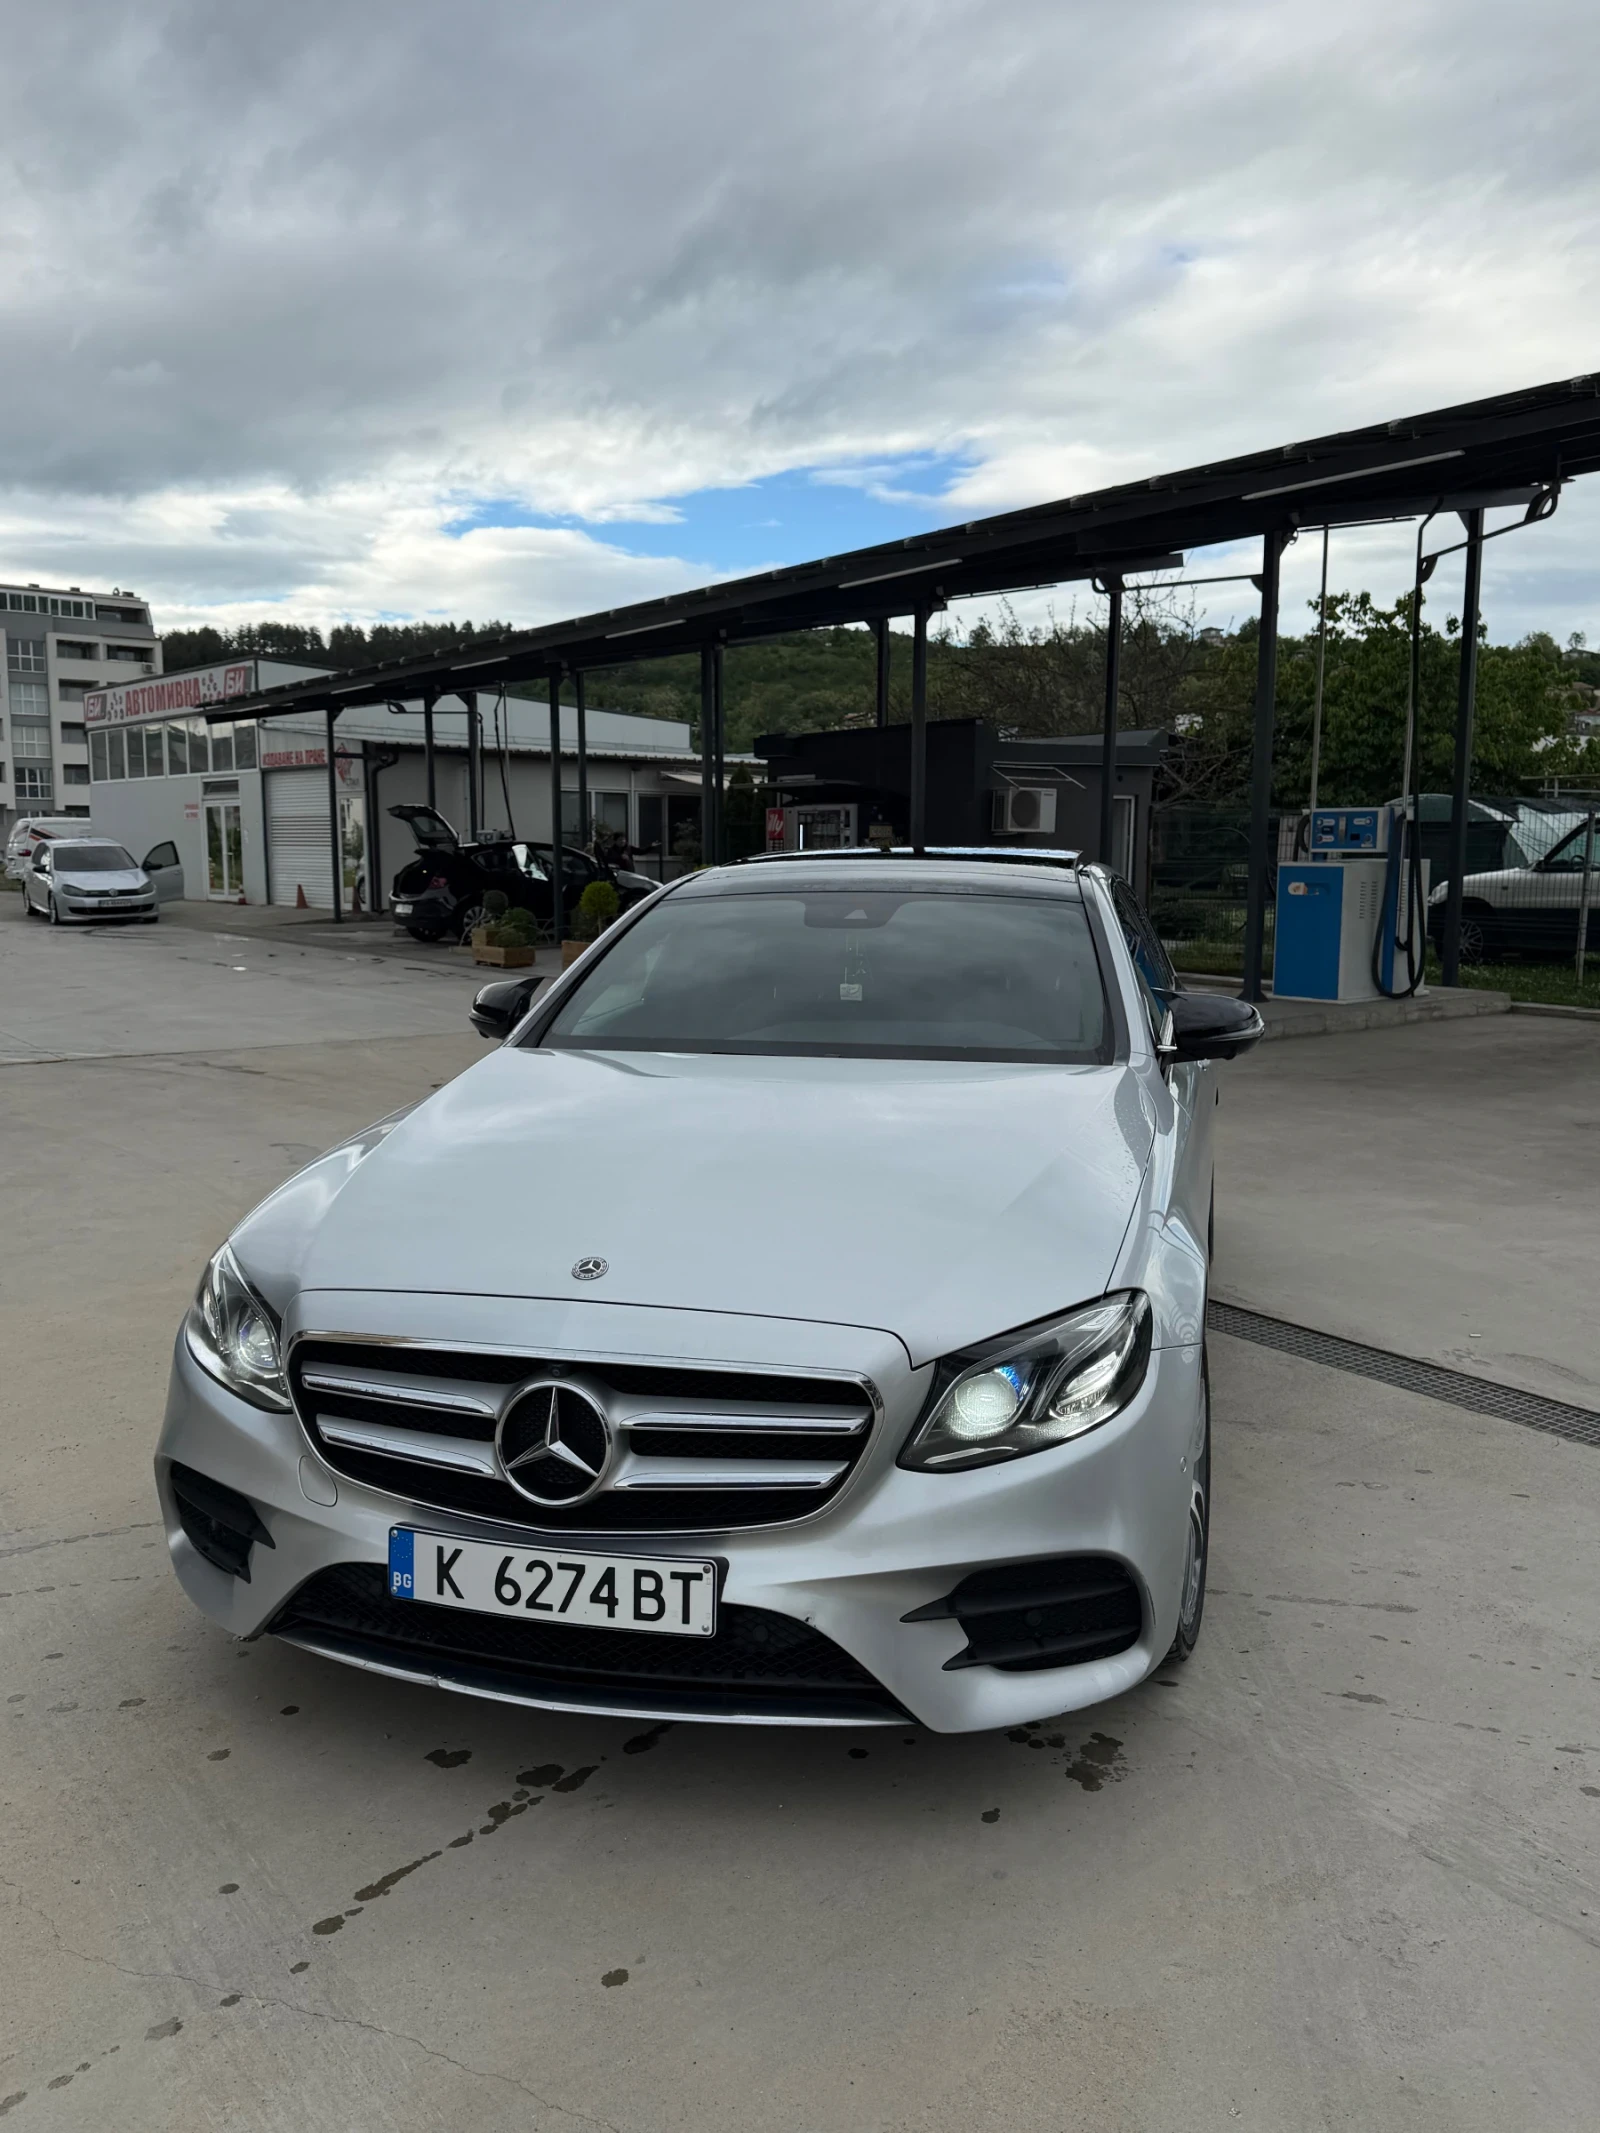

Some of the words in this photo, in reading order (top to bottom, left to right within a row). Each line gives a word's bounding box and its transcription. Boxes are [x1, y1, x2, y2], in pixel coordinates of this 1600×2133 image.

[125, 677, 200, 717] АВТОМИВКА
[768, 814, 784, 836] illy
[393, 1571, 412, 1589] BG
[436, 1545, 465, 1600] K
